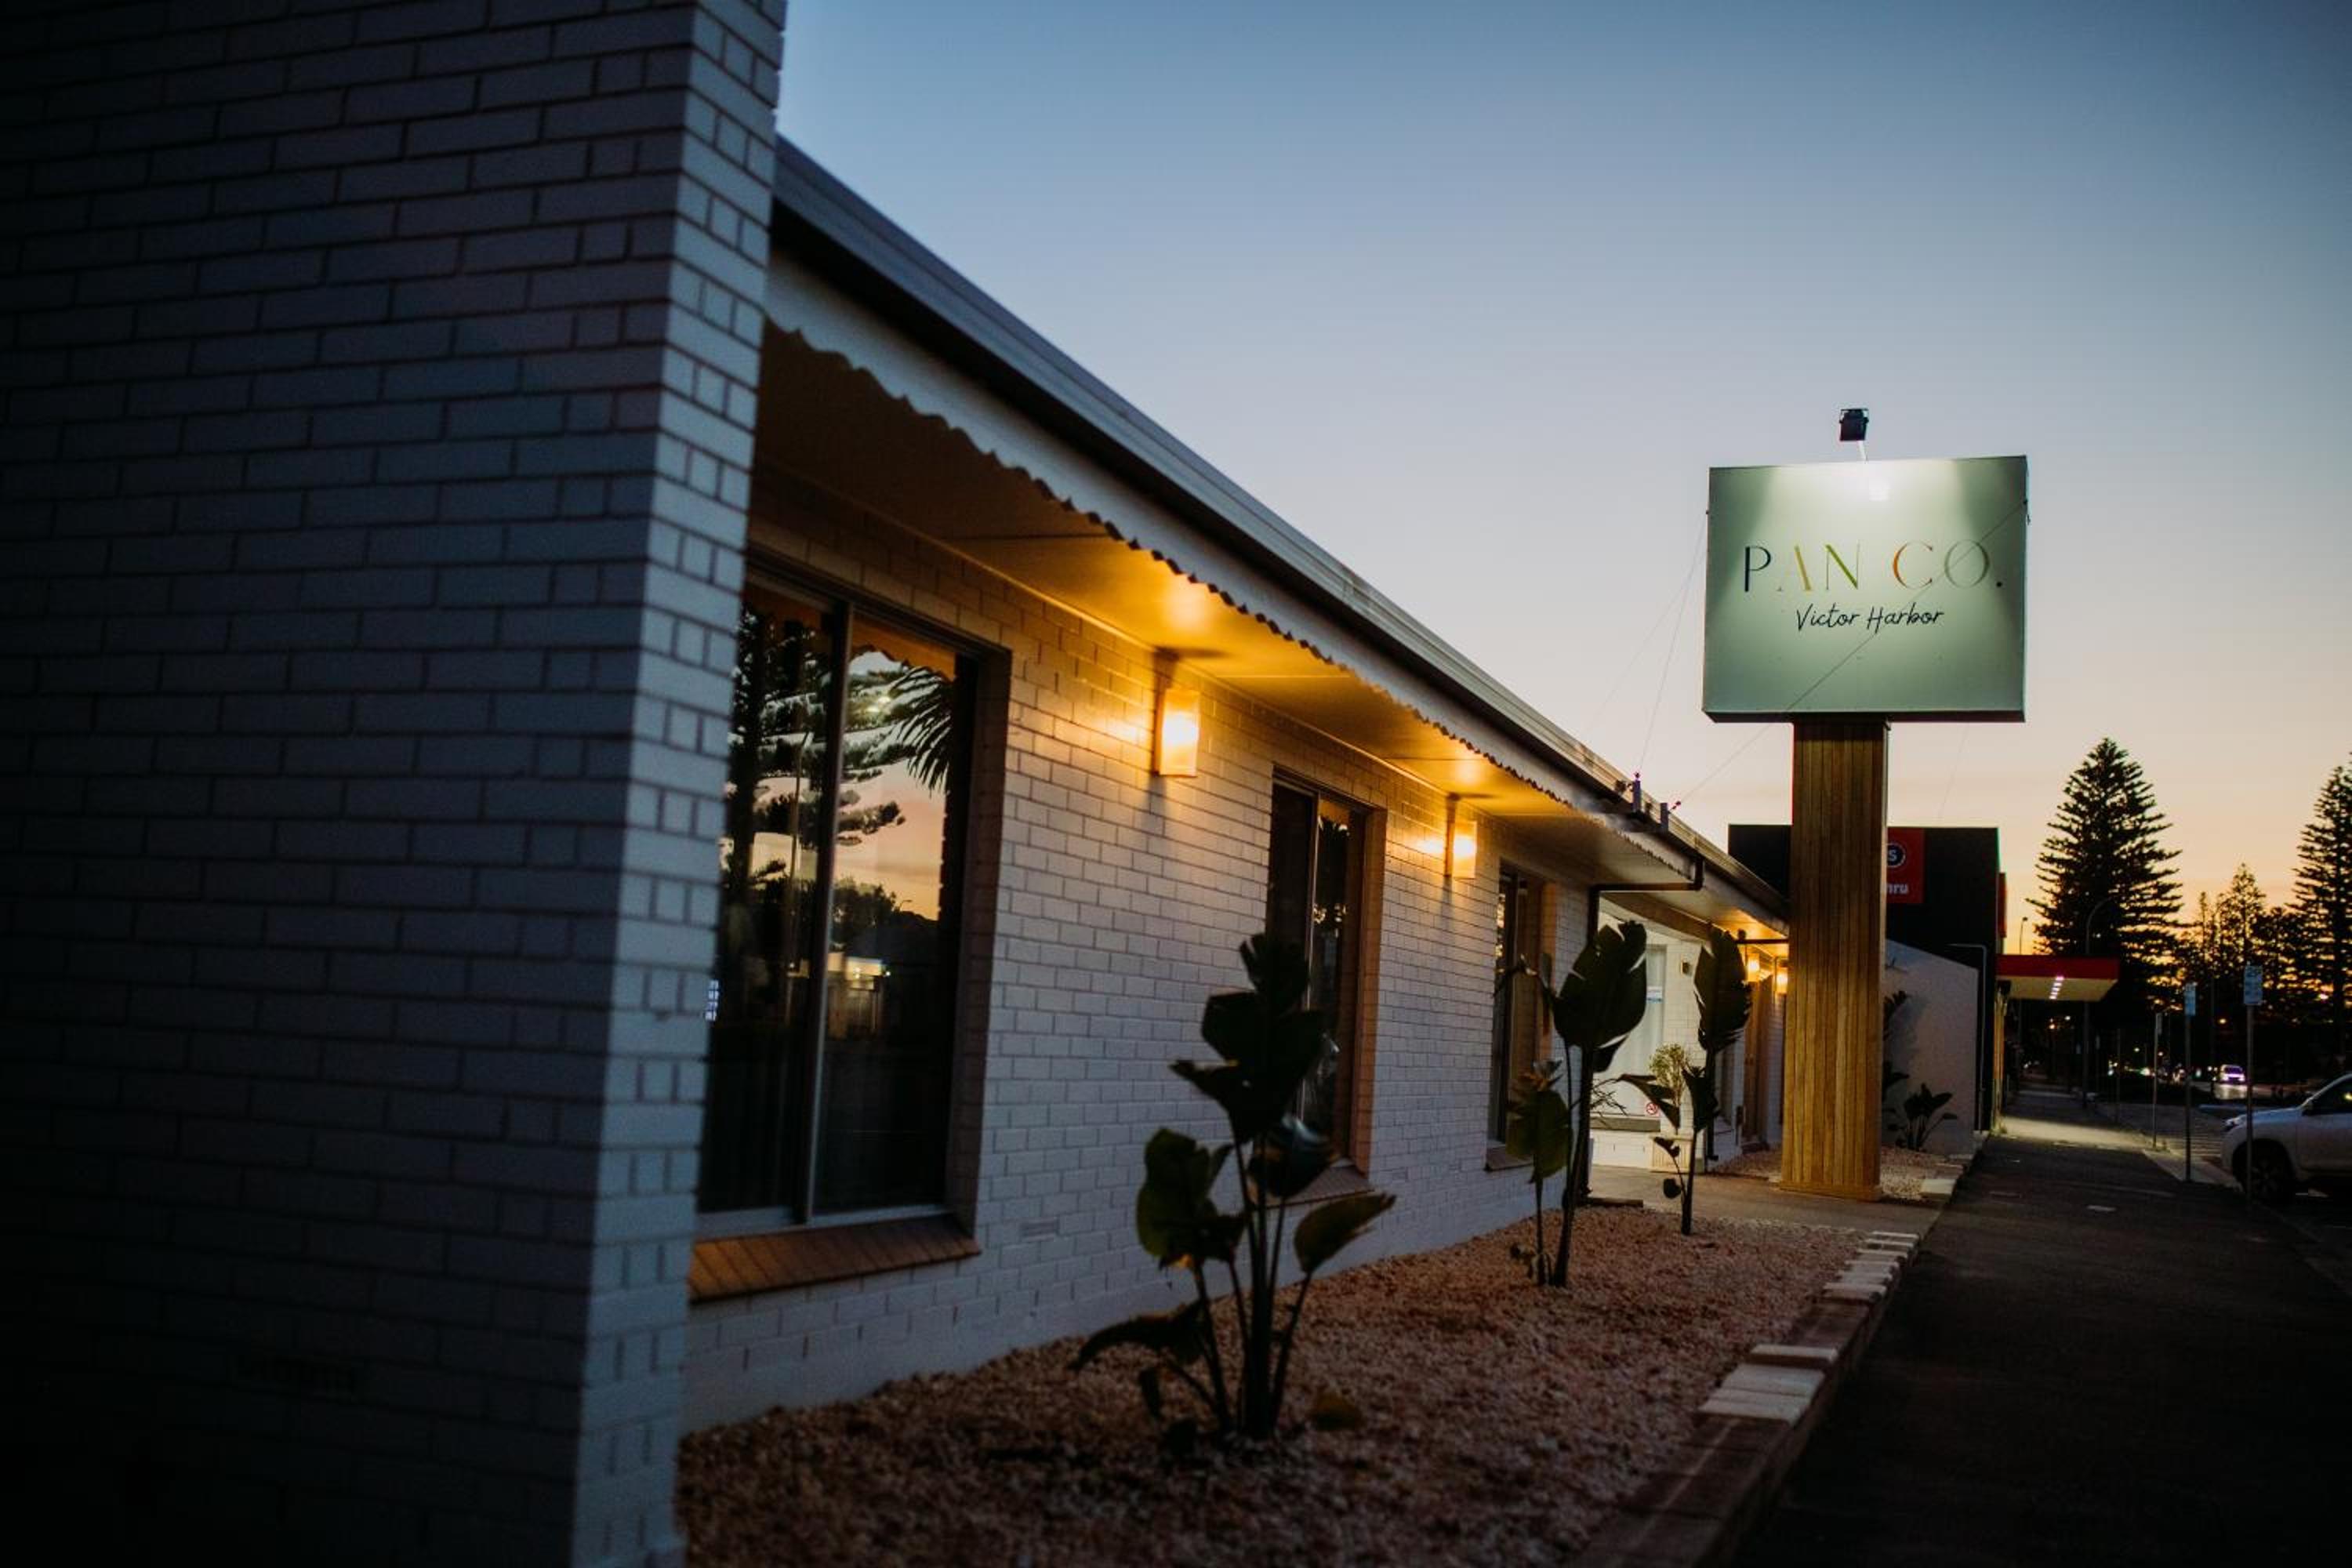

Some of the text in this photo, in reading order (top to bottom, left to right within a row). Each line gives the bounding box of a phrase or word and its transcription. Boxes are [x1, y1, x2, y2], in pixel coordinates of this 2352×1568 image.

[1744, 540, 2003, 593] PAN CO.
[1796, 602, 1945, 635] Victor Harbor
